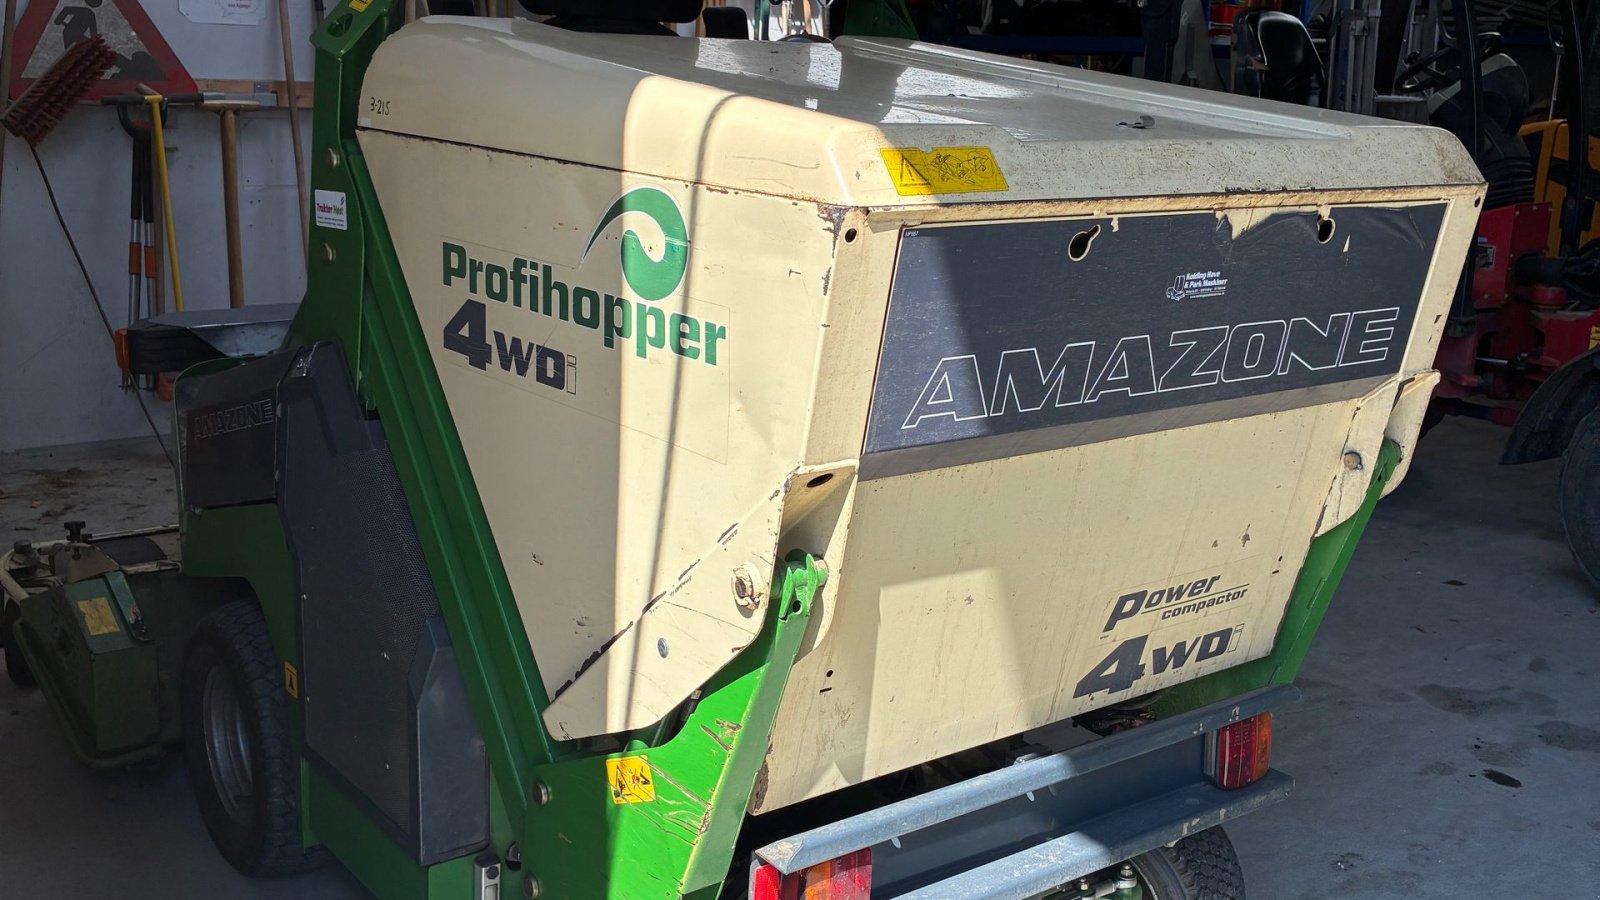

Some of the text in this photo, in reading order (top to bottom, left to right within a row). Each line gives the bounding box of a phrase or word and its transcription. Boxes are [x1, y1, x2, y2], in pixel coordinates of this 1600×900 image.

[370, 96, 391, 116] 3-215
[1189, 280, 1202, 288] Park
[442, 241, 727, 366] Profihopper
[900, 306, 1400, 429] AMAZONE
[193, 398, 274, 440] AMAZONE
[1161, 588, 1248, 621] compactor
